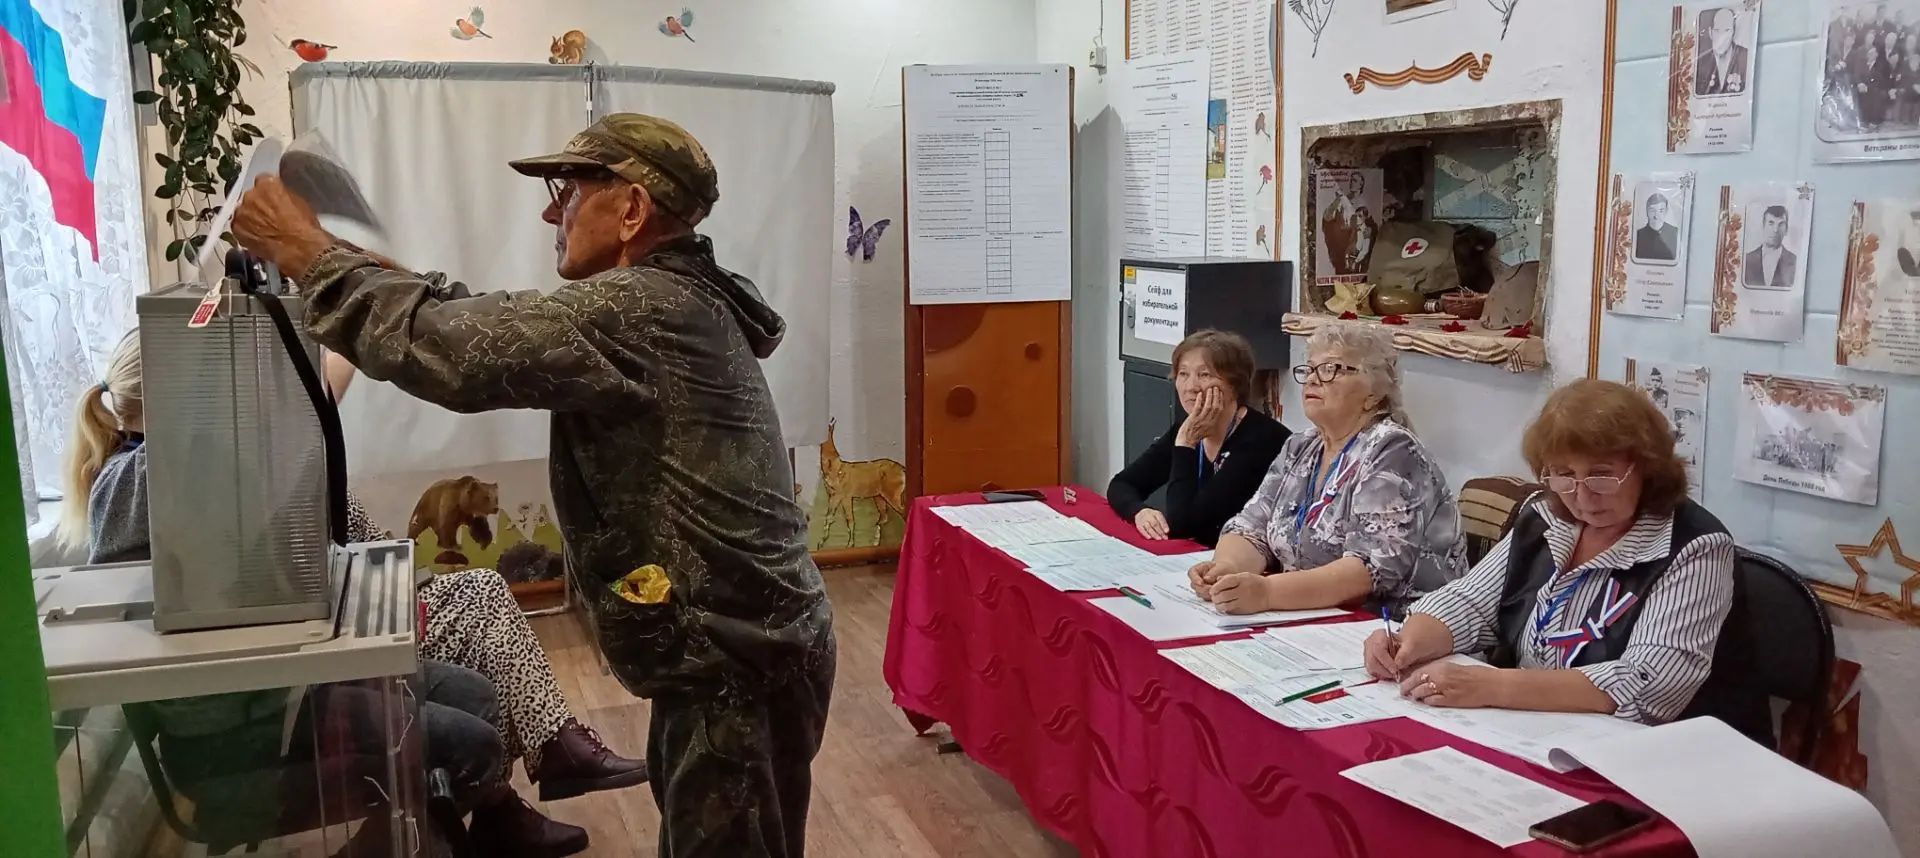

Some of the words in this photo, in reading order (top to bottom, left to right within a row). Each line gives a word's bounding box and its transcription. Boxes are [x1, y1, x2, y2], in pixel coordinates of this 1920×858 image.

[1147, 285, 1161, 296] Сейф
[1162, 288, 1172, 296] для
[1142, 299, 1178, 311] избирательной
[1143, 316, 1179, 328] документации
[1763, 474, 1777, 483] День
[1778, 477, 1800, 487] Победы
